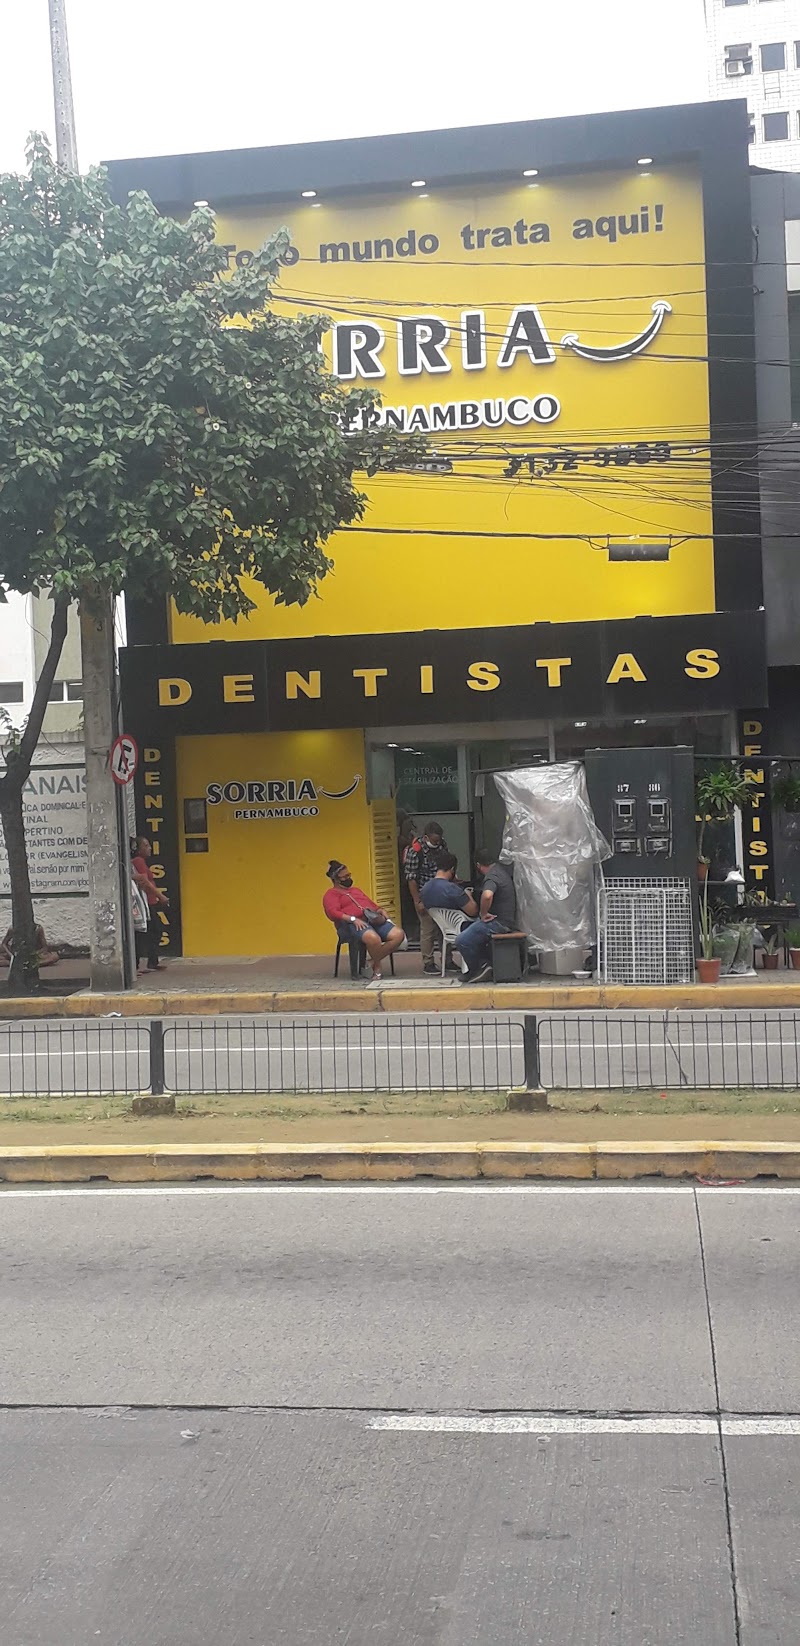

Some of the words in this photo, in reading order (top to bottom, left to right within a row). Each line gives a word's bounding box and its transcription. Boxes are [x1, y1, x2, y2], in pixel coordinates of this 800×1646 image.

[222, 244, 300, 267] Too
[318, 230, 439, 263] mundo
[460, 218, 549, 250] trata
[572, 203, 665, 242] aqui!
[316, 304, 556, 380] RRIA
[158, 647, 722, 707] DENTISTAS
[403, 767, 439, 775] CENTRAL
[441, 766, 453, 774] DE
[206, 778, 318, 805] SORRIA
[234, 806, 320, 821] PERNAMBUCO
[57, 837, 75, 846] COM
